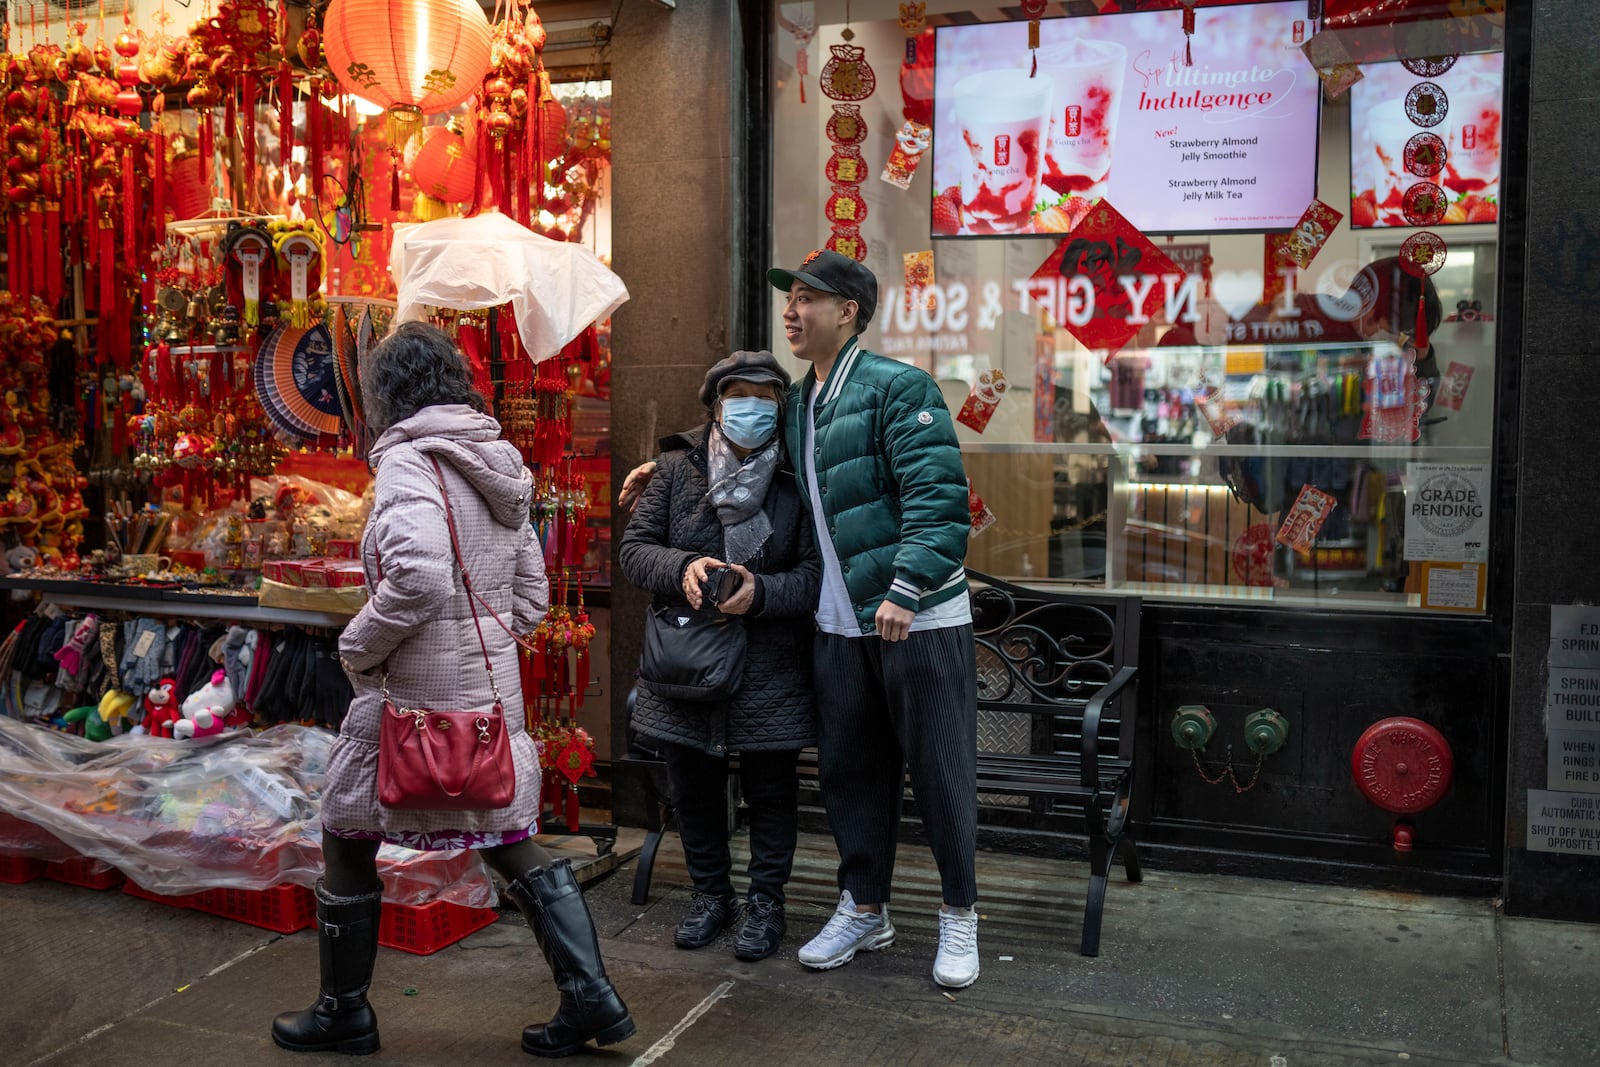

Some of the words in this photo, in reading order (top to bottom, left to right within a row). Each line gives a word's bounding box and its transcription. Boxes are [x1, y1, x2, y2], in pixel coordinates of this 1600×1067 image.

[1165, 64, 1273, 89] Ultimate
[1138, 90, 1273, 112] Indulgence
[1154, 126, 1179, 139] New!
[1170, 138, 1219, 149] Strawberry
[1222, 136, 1258, 147] Almond
[1181, 151, 1201, 162] Jelly
[1203, 150, 1247, 160] Smoothie
[1168, 178, 1218, 189] Strawberry
[1221, 176, 1257, 187] Almond
[1182, 191, 1202, 202] Jelly
[1204, 190, 1224, 199] Milk
[1226, 189, 1243, 199] Tea
[1421, 489, 1476, 503] GRADE
[1412, 503, 1483, 518] PENDING
[1562, 741, 1595, 753] WHEN
[1563, 755, 1595, 768] RINGS
[1565, 771, 1589, 782] FIRE
[1571, 797, 1593, 810] CURB
[1541, 806, 1595, 821] AUTOMATIC
[1531, 824, 1556, 838] SHUT
[1559, 826, 1577, 839] OFF
[1548, 836, 1593, 851] OPPOSITE
